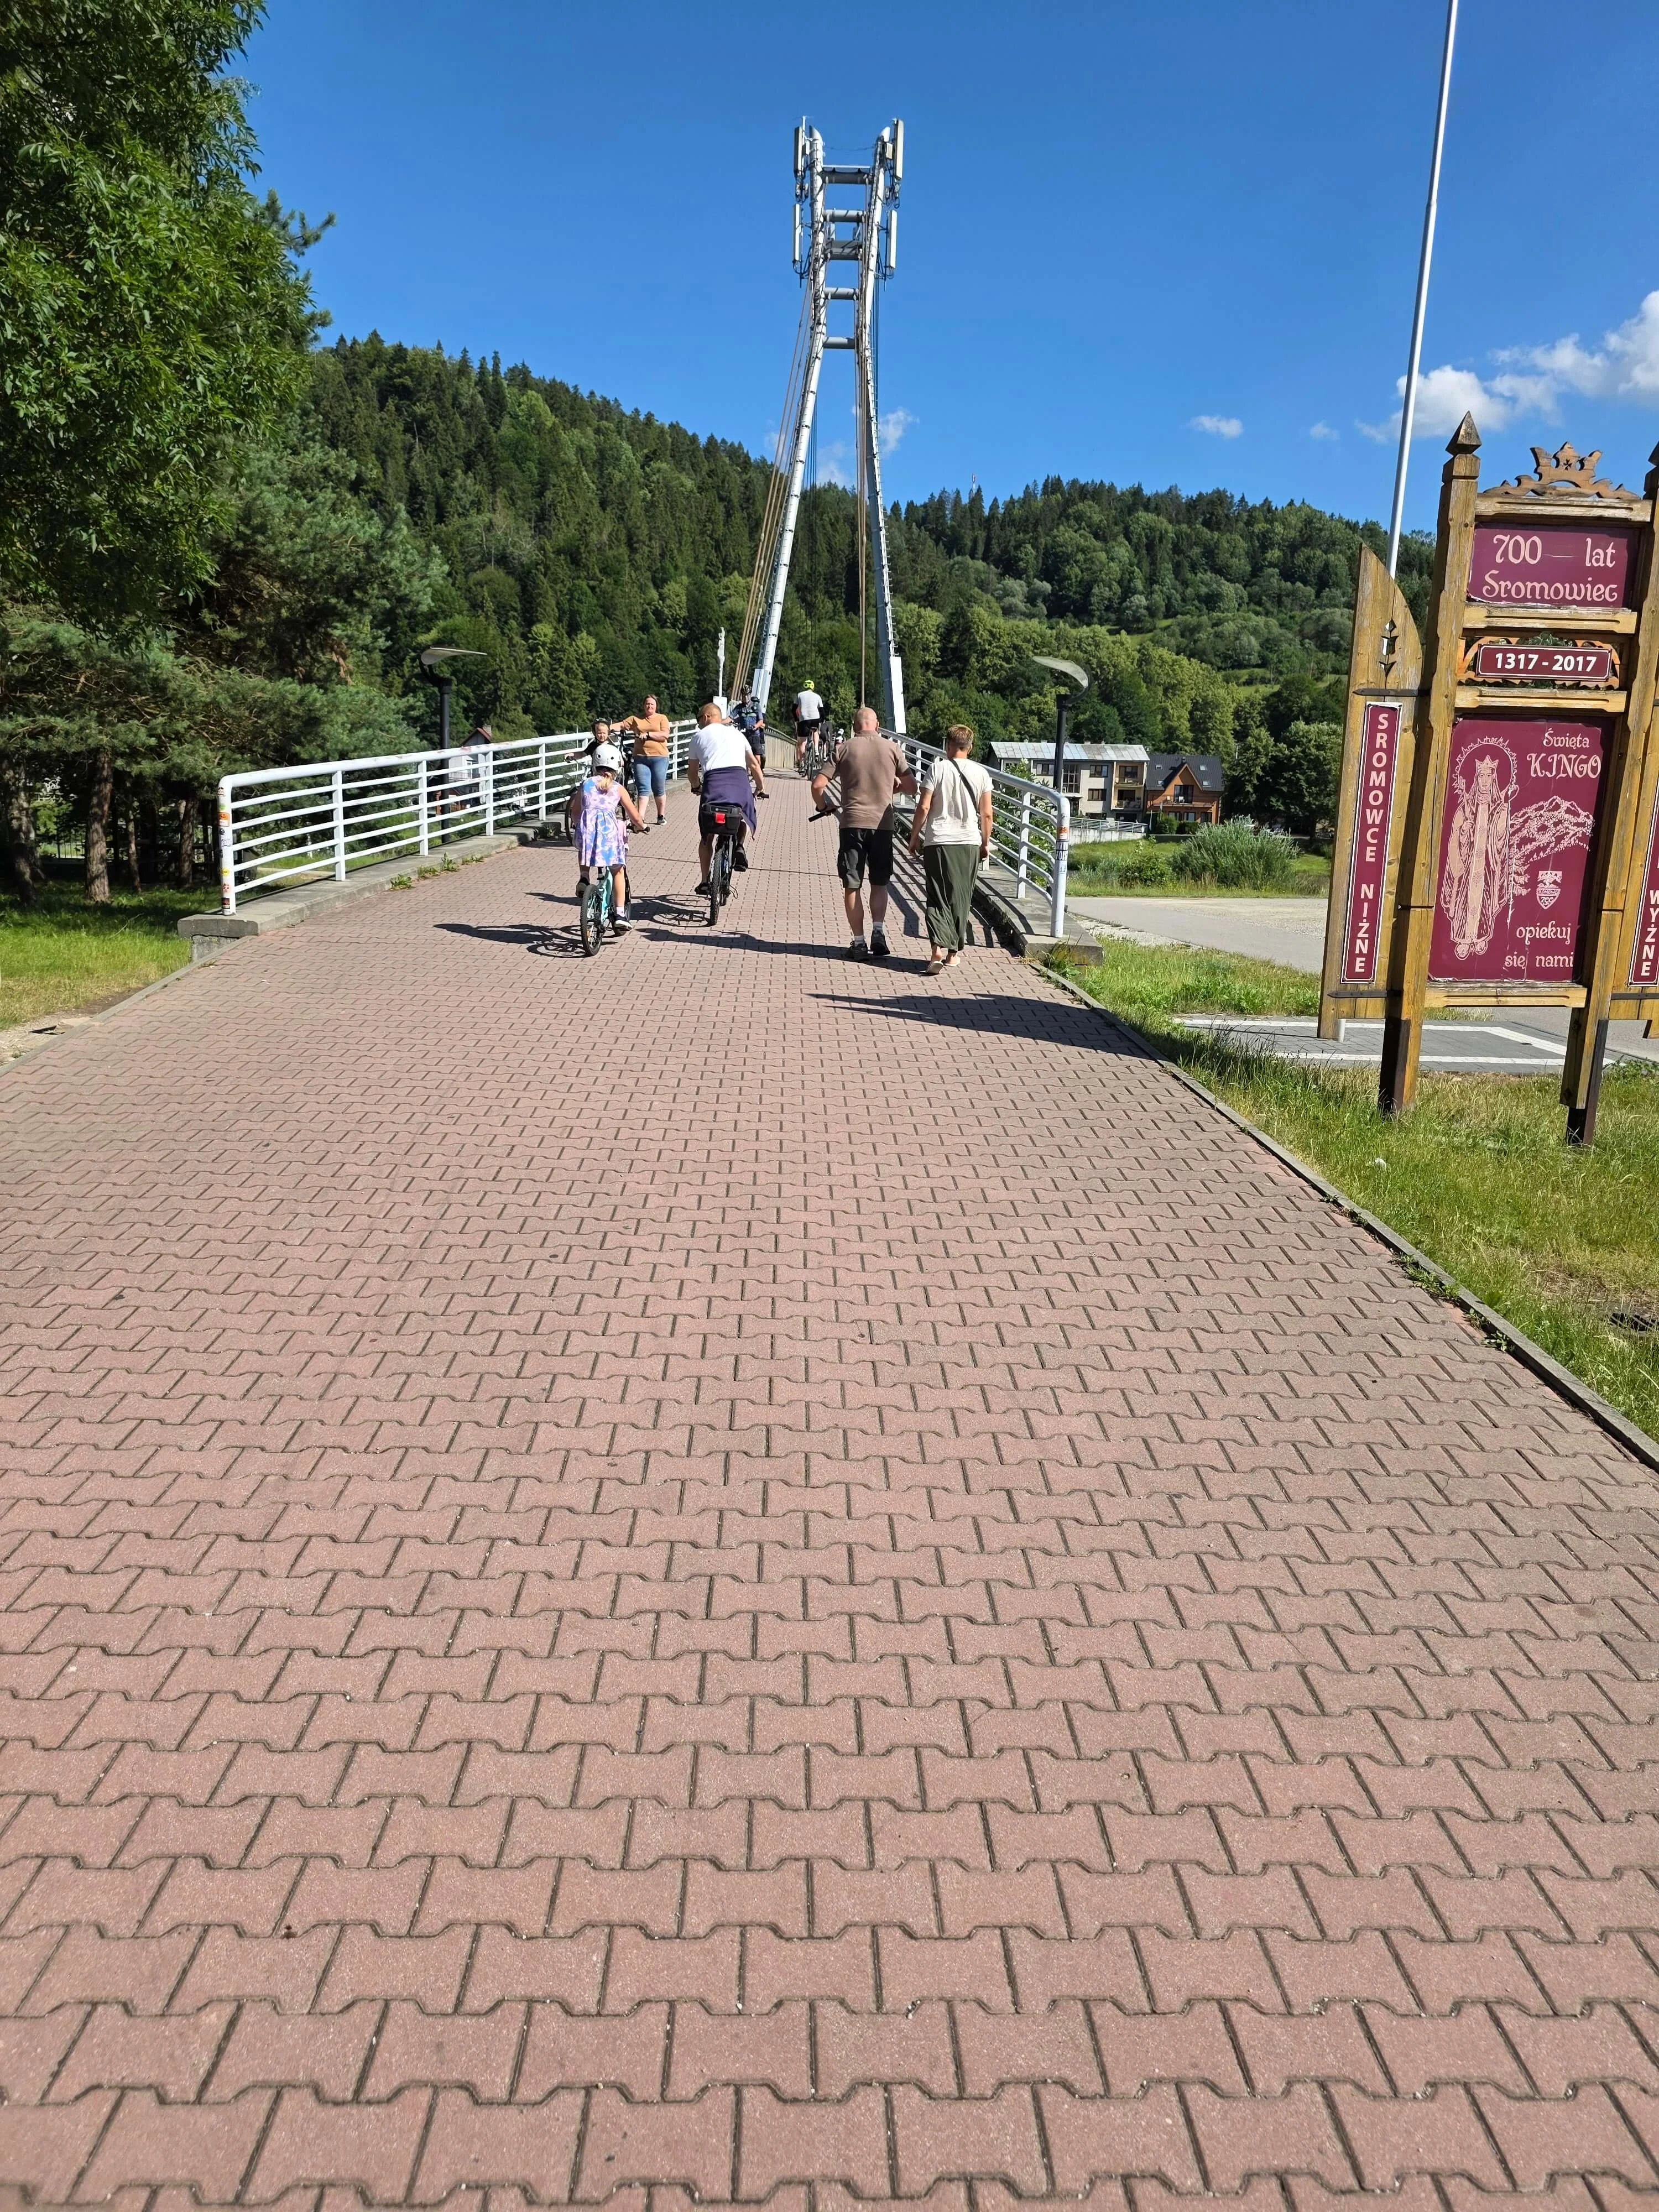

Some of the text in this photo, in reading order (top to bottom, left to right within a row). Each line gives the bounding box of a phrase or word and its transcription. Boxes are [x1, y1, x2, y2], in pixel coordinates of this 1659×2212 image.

[1493, 534, 1616, 568] 700 lat
[1482, 570, 1618, 603] Sromowiec
[1495, 653, 1539, 670] 1317
[1552, 655, 1597, 672] 2017
[1543, 727, 1590, 750] Święta
[1526, 753, 1602, 780] KINGO
[1355, 713, 1389, 973] SROMOWCE NIŻNE
[1516, 920, 1571, 946] opiekuj
[1504, 951, 1574, 969] się nami
